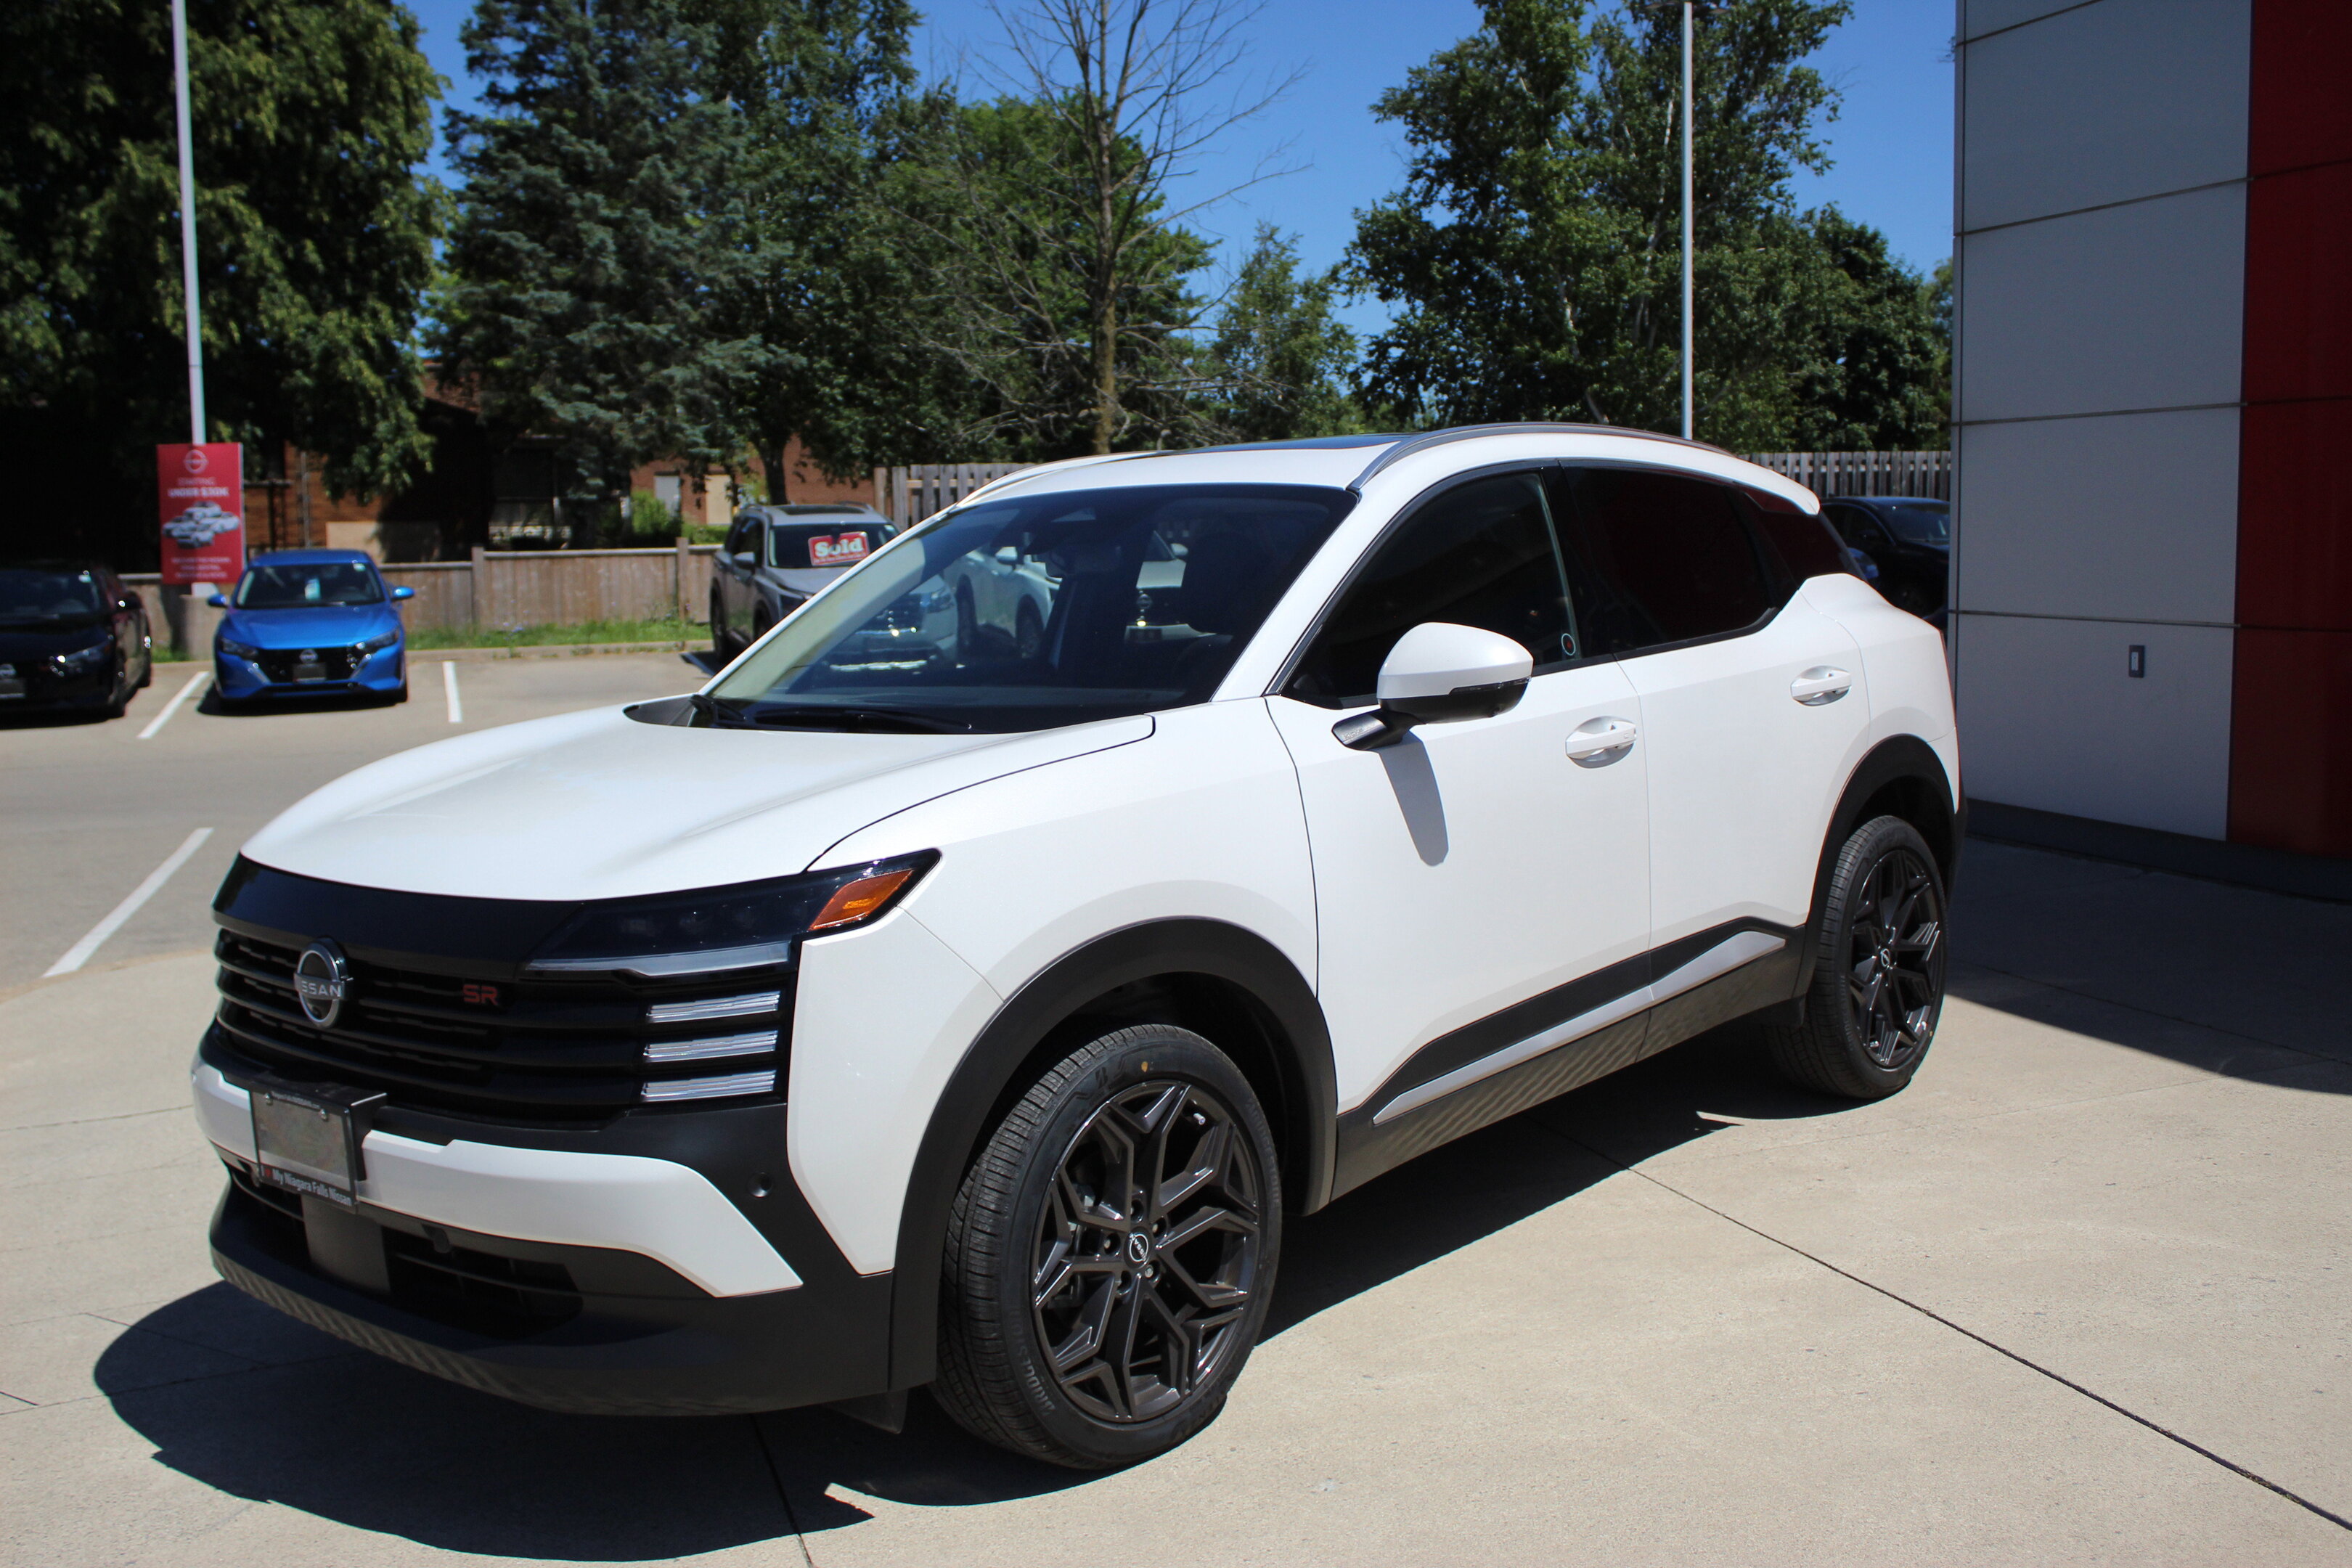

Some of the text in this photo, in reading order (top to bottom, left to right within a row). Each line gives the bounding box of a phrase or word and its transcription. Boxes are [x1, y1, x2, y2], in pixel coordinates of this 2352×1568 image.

[814, 538, 864, 557] Sold
[463, 984, 498, 1005] SR
[272, 1168, 284, 1185] My
[284, 1172, 312, 1192] Niagara
[312, 1181, 329, 1198] Falls
[329, 1186, 353, 1206] Nissan
